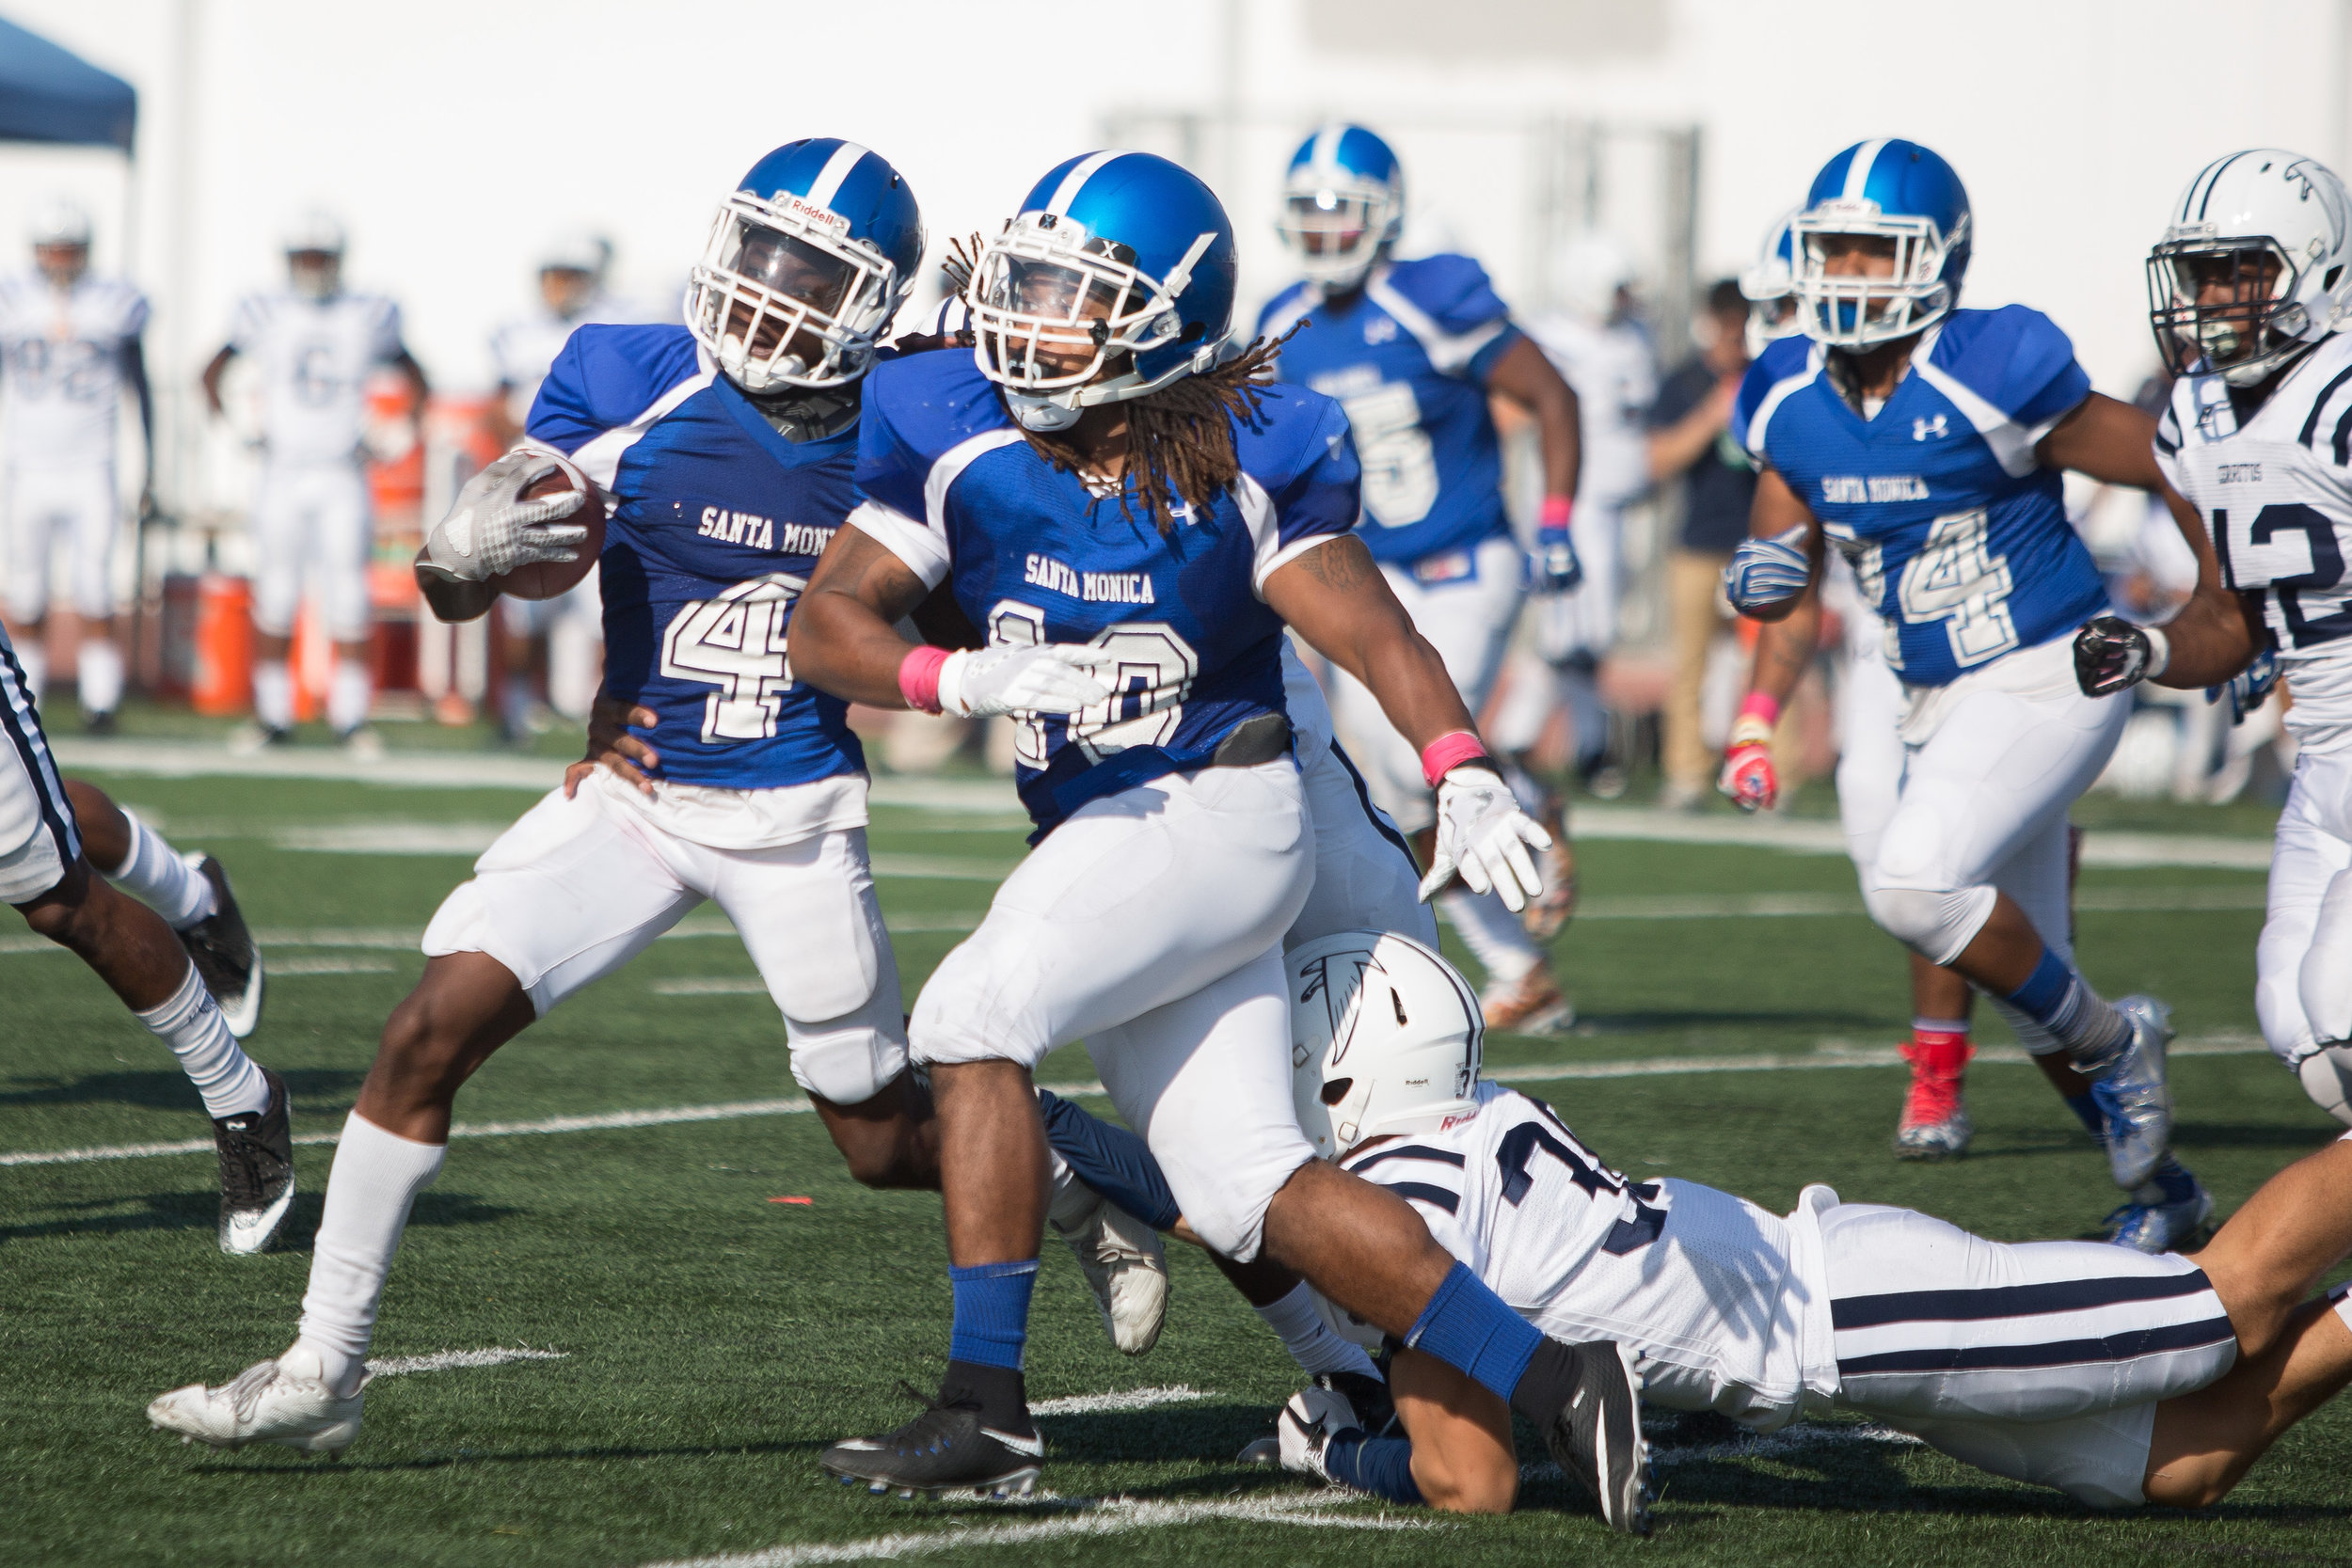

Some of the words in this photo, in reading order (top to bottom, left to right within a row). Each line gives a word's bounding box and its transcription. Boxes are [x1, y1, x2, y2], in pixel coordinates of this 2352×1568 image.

[792, 199, 834, 226] Riddell
[698, 506, 773, 550] SANTA
[781, 522, 836, 557] MON
[1025, 553, 1079, 598] SANTA
[1083, 573, 1155, 604] MONICA
[660, 572, 807, 744] 4
